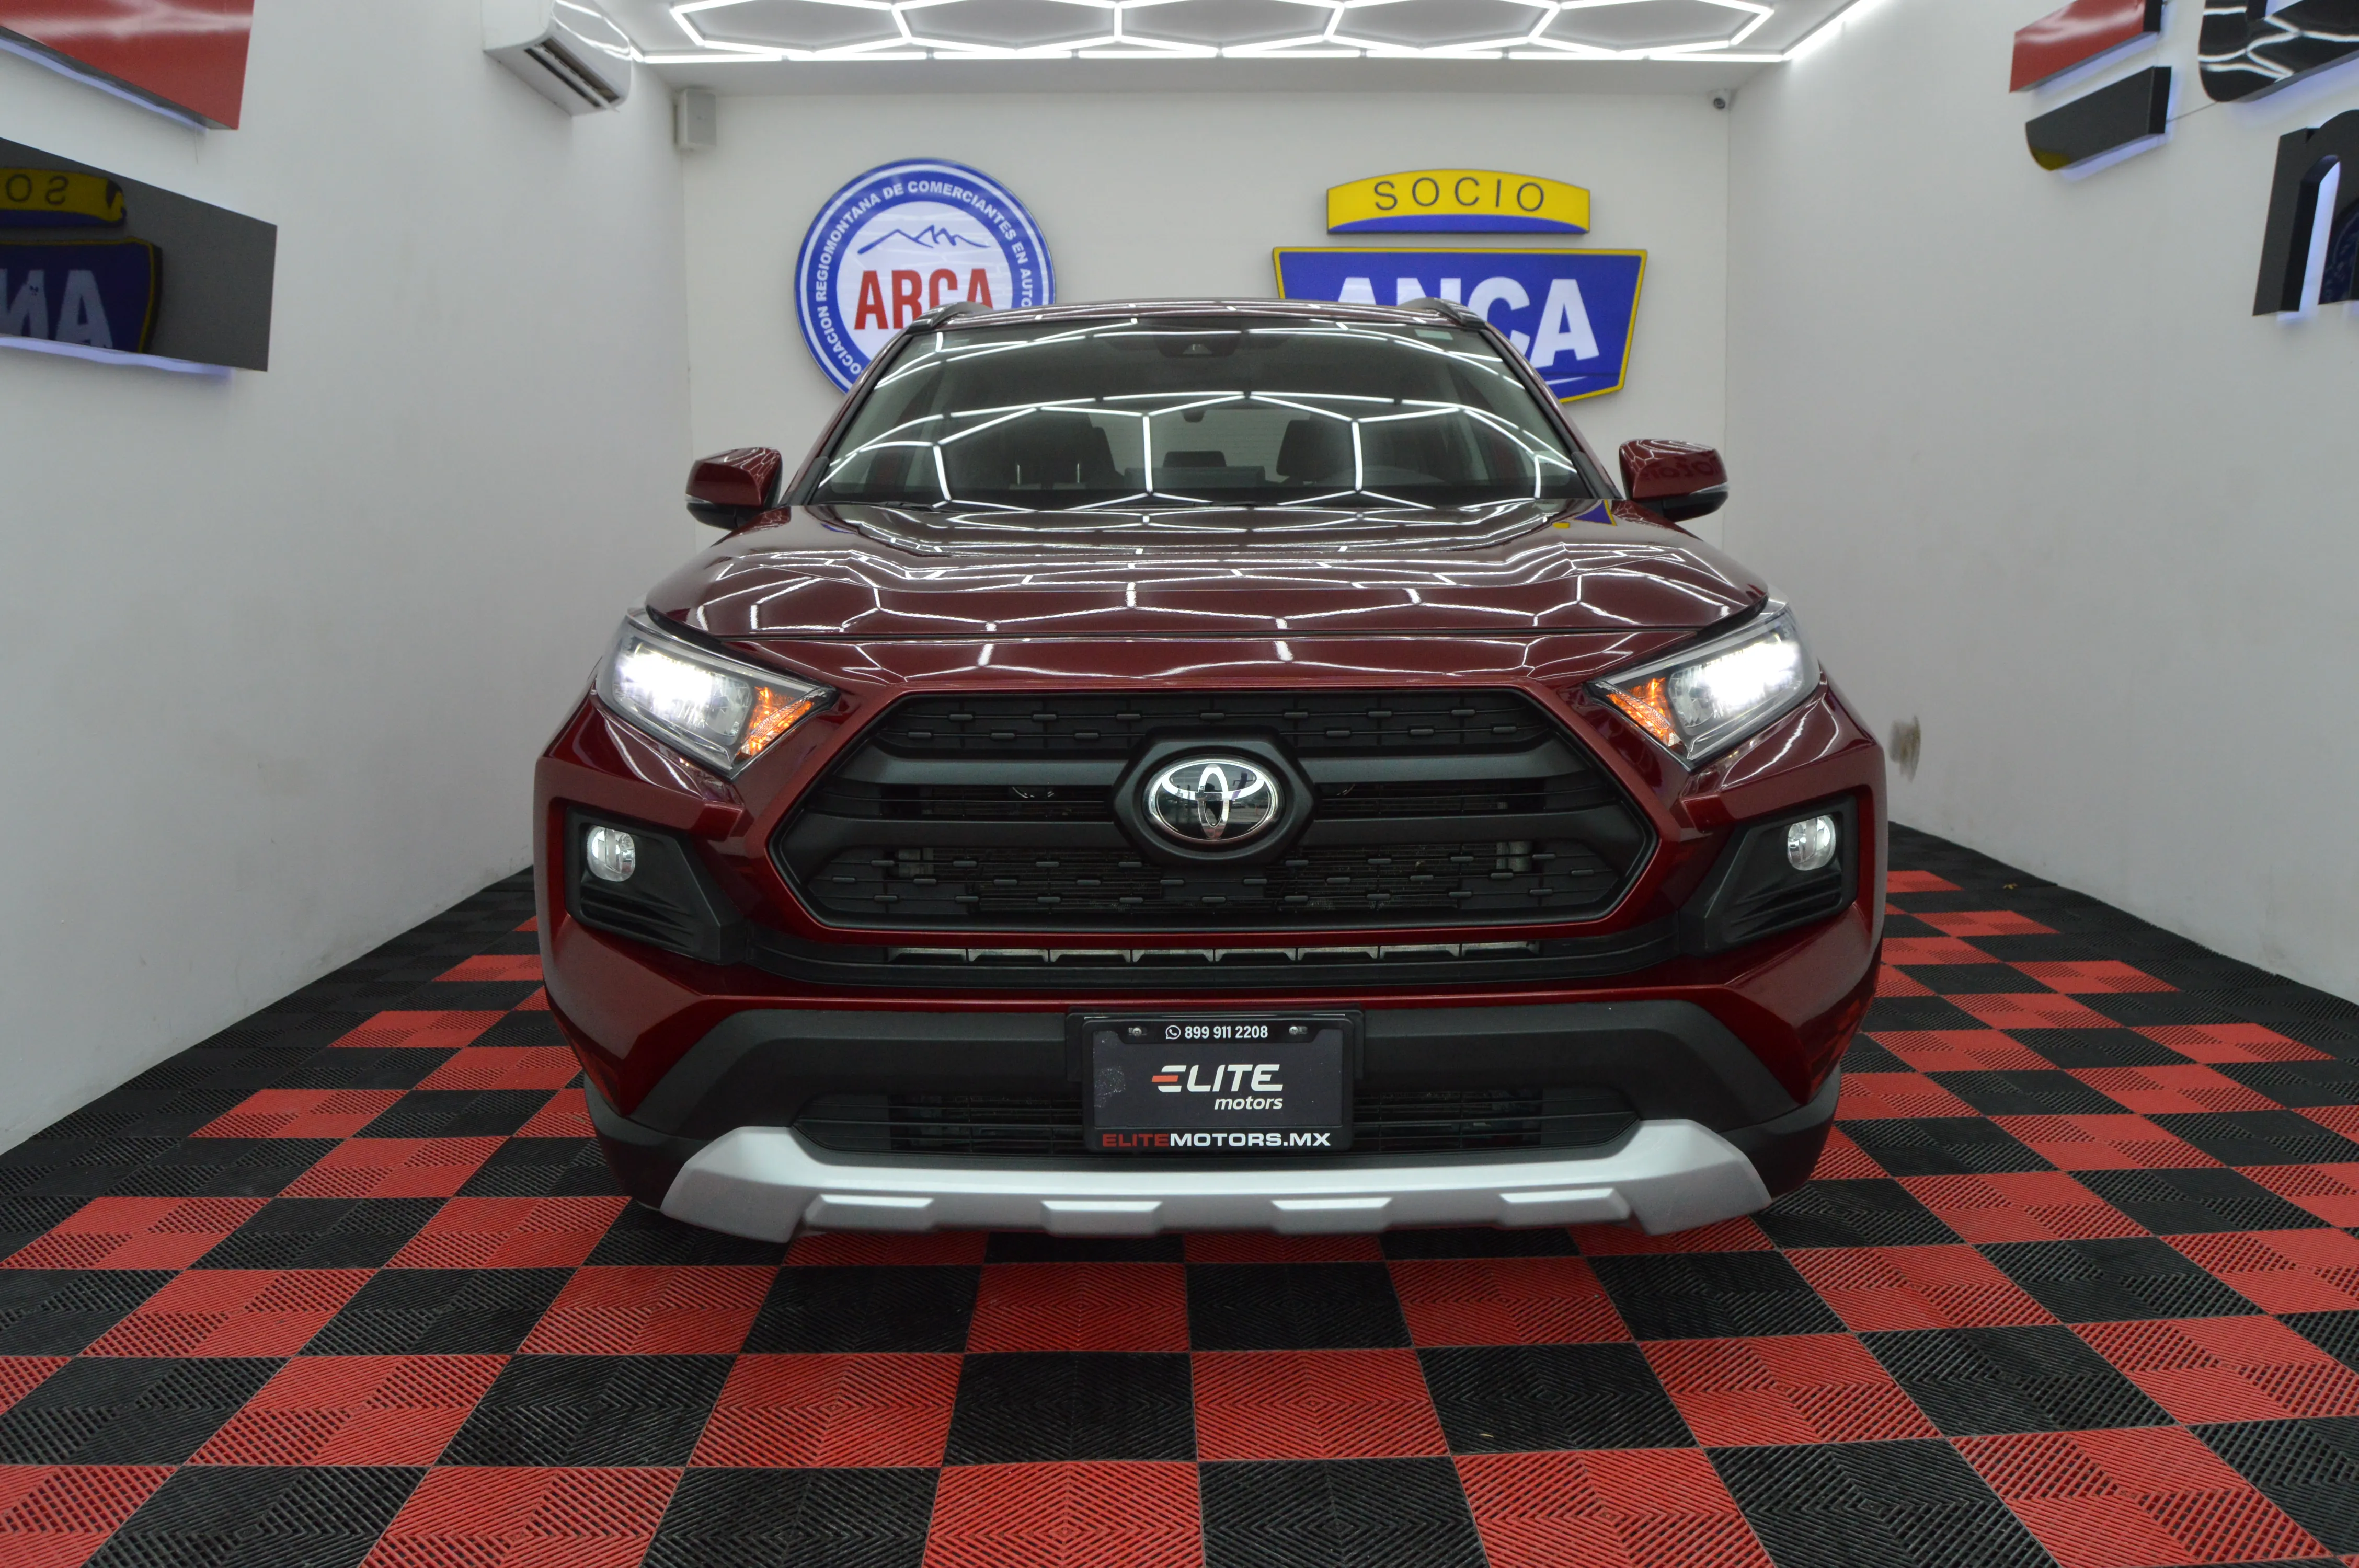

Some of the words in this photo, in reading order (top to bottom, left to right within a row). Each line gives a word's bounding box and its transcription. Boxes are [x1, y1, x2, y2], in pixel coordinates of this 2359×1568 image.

[882, 183, 904, 200] DE
[1373, 176, 1545, 212] SOCIO
[907, 180, 1017, 241] COMERCIANTES
[815, 193, 883, 302] REGIOMONTANA
[1011, 241, 1029, 265] EN
[854, 268, 994, 330] ARCA
[817, 305, 864, 375] OCIACION
[1184, 1025, 1210, 1039] 899
[1213, 1025, 1231, 1039] 911
[1235, 1025, 1268, 1039] 2208
[1151, 1064, 1284, 1093] ELITE
[1214, 1096, 1283, 1110] motors
[1102, 1132, 1331, 1147] ELITEMOTORS.MX
